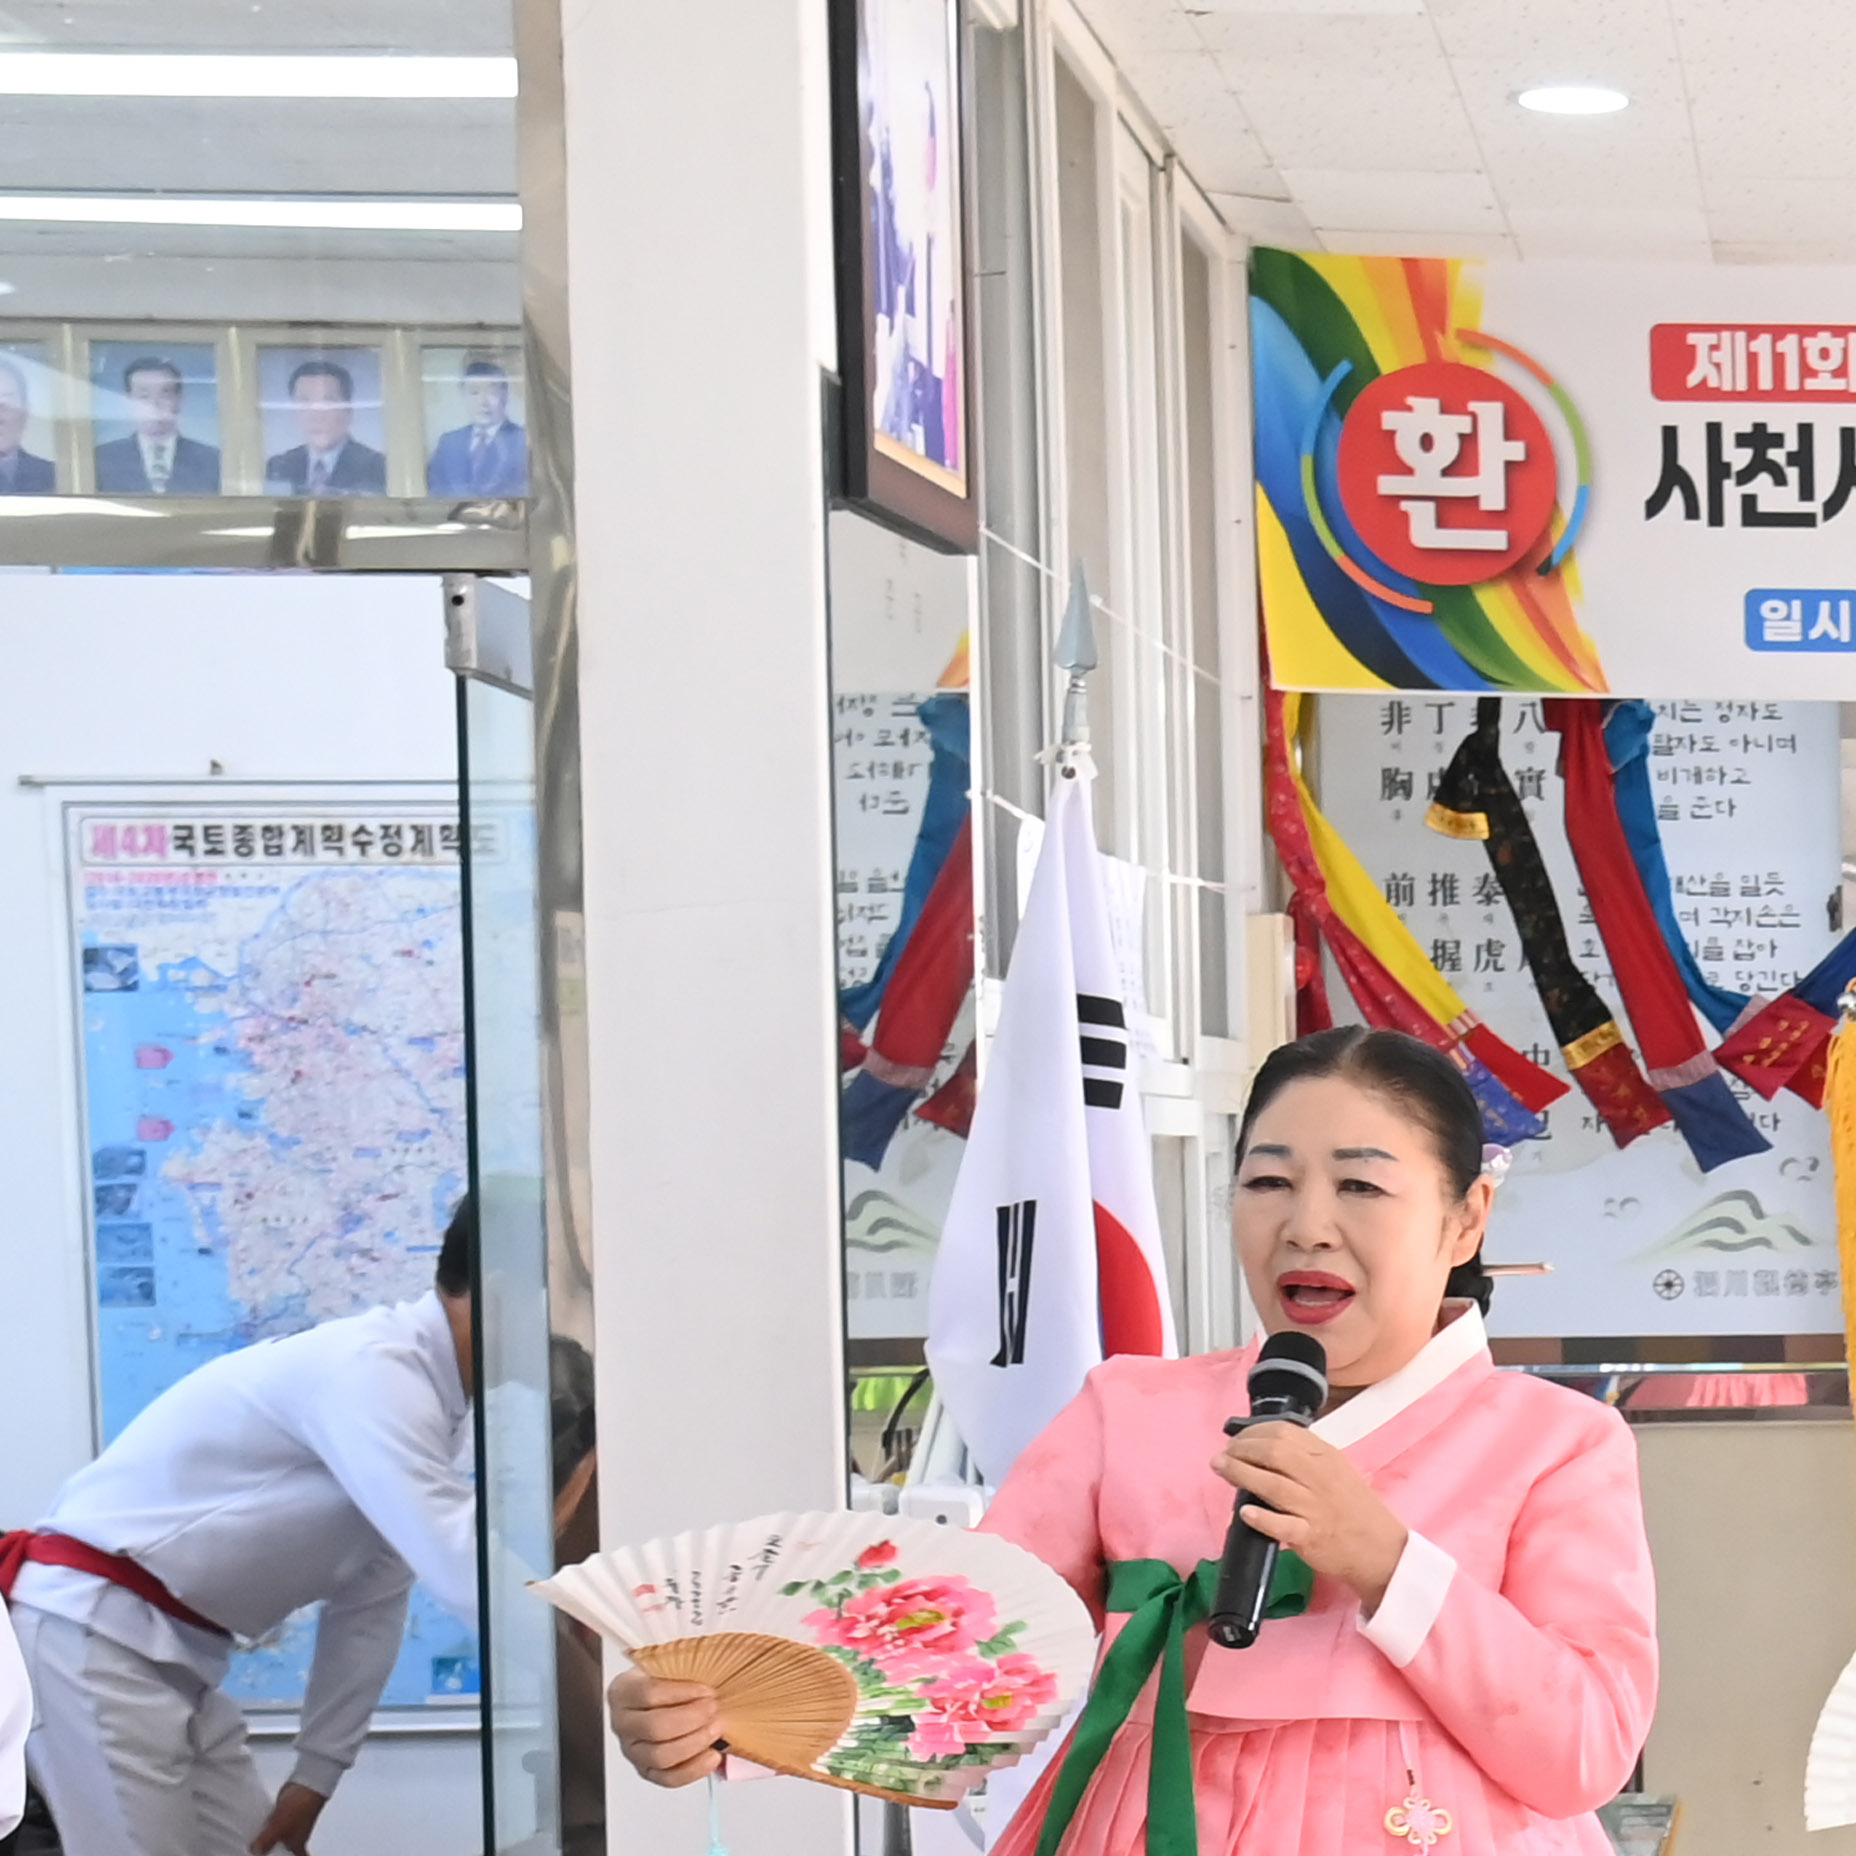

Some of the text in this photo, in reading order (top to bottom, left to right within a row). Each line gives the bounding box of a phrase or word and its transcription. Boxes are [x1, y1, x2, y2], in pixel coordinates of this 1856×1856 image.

[1376, 395, 1526, 551] 환
[1758, 598, 1854, 645] 일시
[1380, 700, 1548, 735] 非丁八
[1728, 732, 1798, 755] 아니며
[1384, 871, 1505, 908] 前推泰
